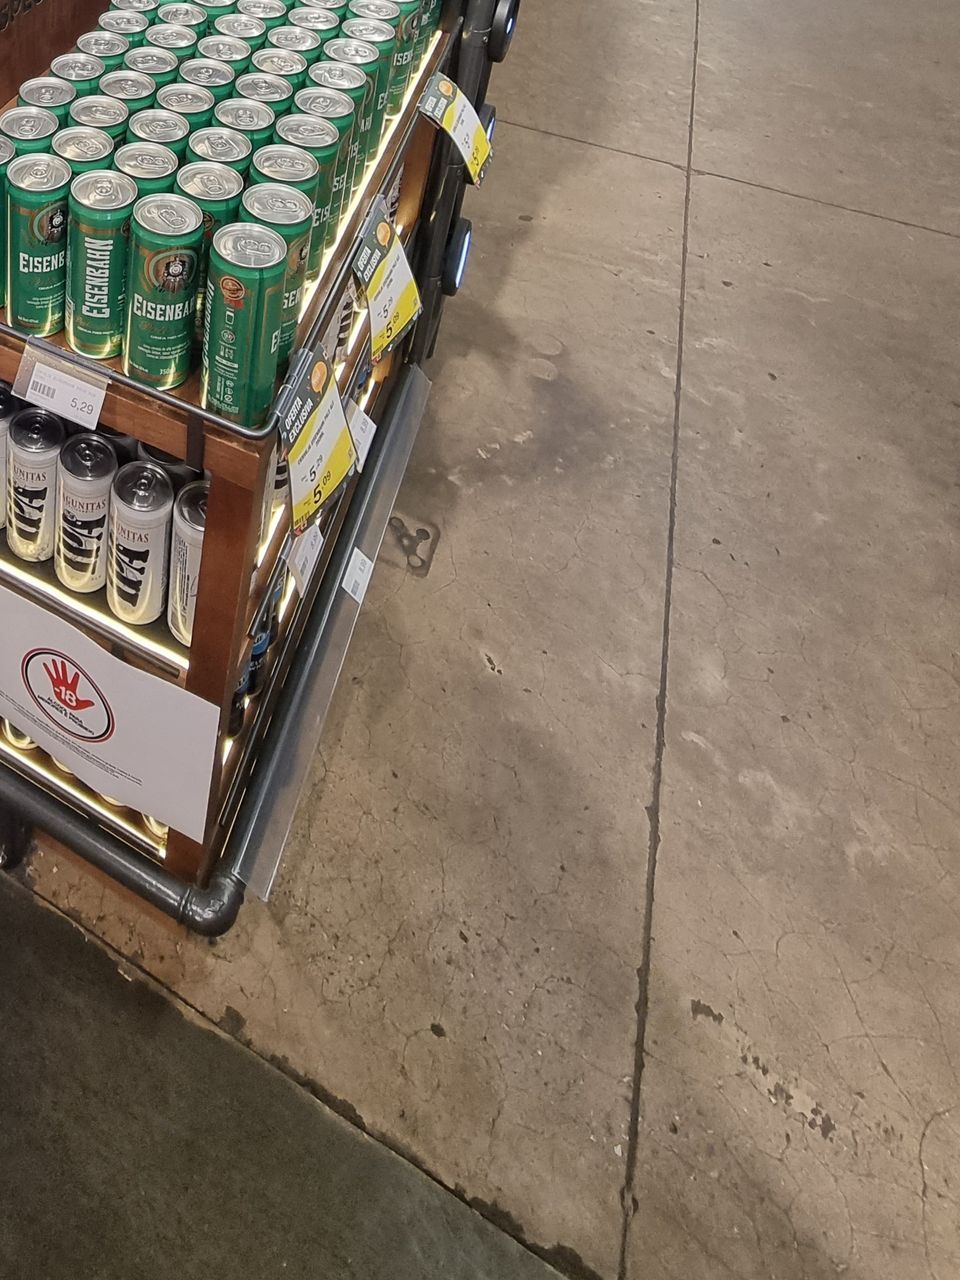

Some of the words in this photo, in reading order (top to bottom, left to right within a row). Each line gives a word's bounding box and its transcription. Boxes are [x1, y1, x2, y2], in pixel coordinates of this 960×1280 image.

[82, 237, 114, 319] EISENBAHN
[71, 397, 93, 416] 5,29
[284, 396, 302, 431] OFERTA
[289, 397, 314, 443] EXCLUSIVA
